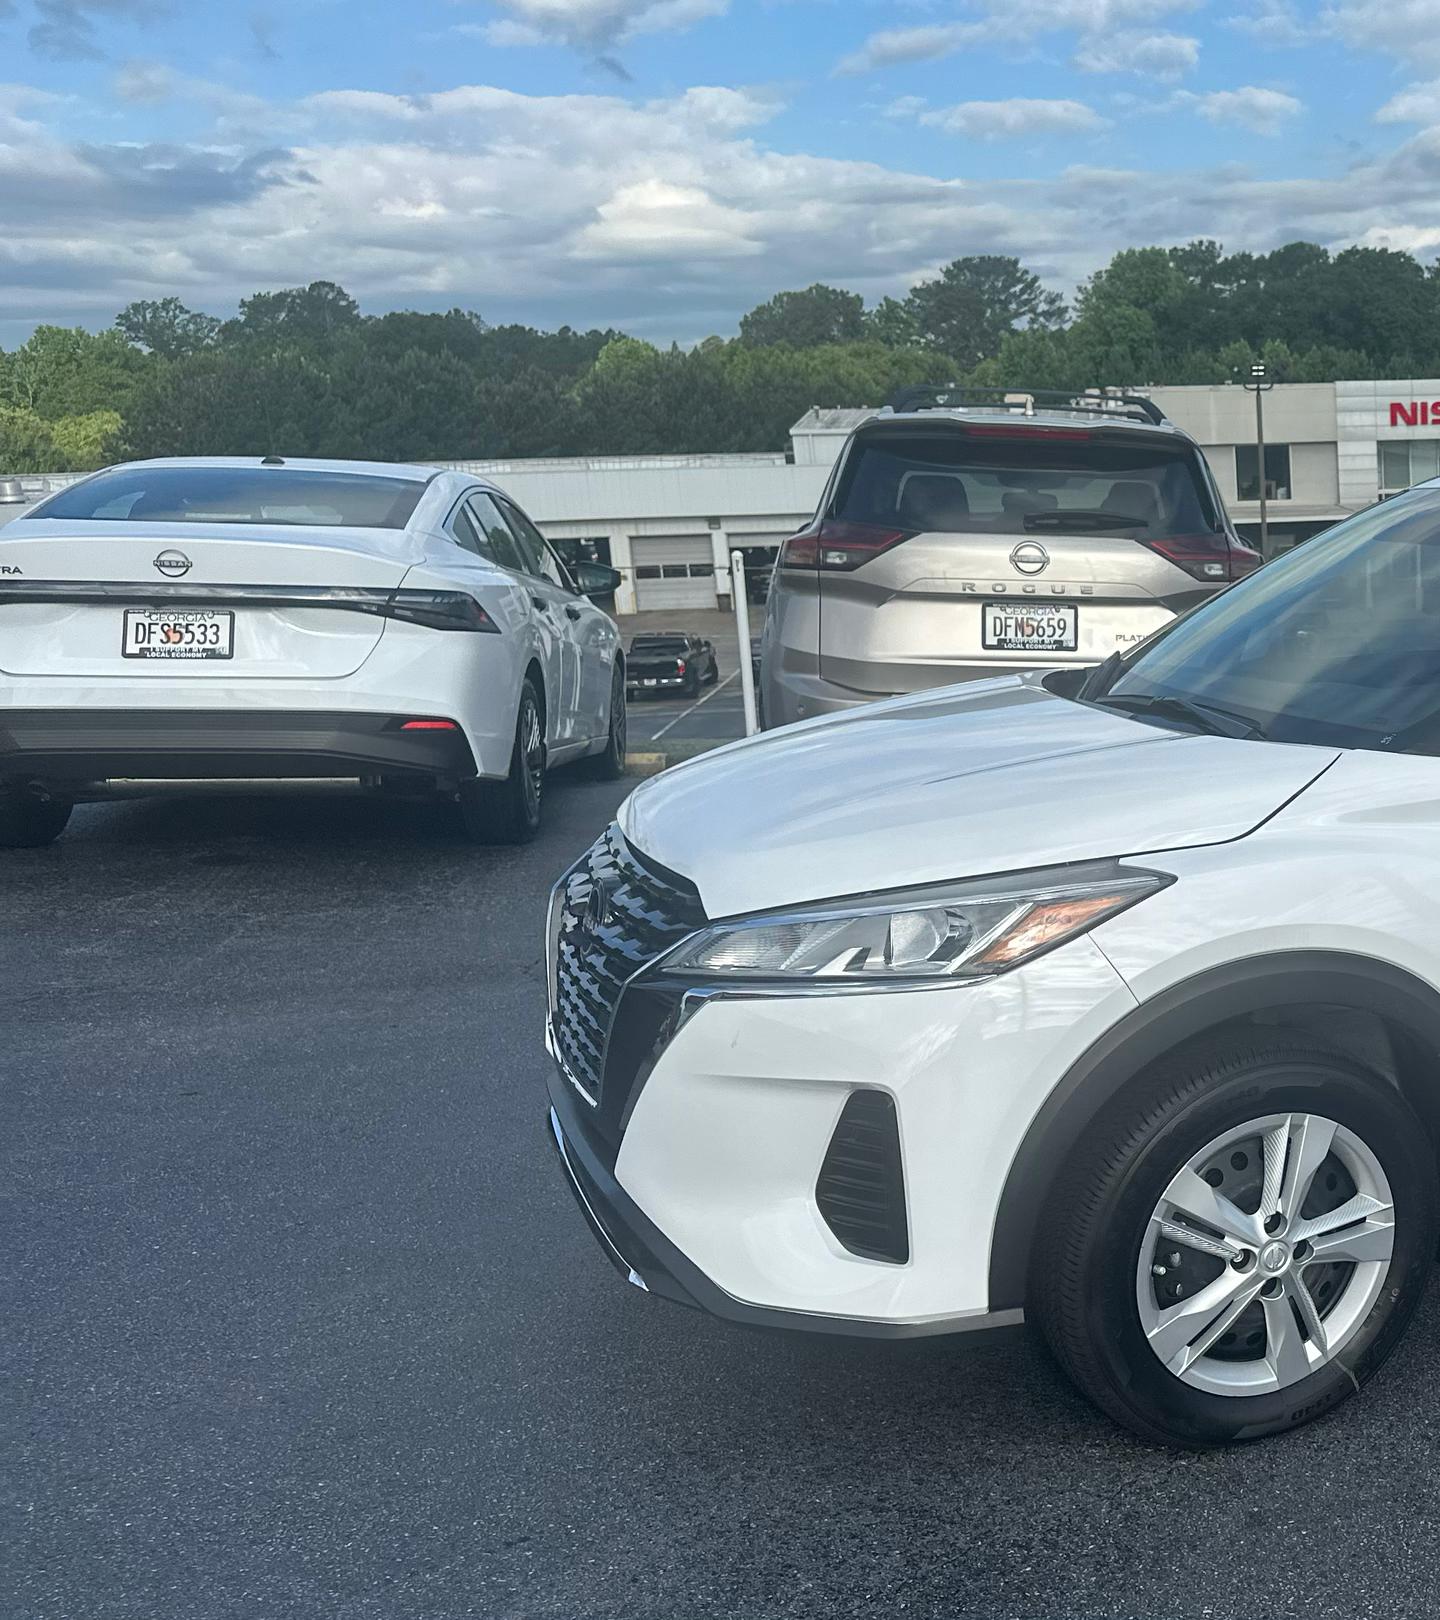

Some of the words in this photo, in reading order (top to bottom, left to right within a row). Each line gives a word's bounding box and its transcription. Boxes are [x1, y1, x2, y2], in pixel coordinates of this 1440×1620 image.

[153, 559, 192, 567] NISSAN
[961, 582, 1094, 595] ROGUE
[1004, 607, 1055, 616] GEORGIA
[149, 613, 207, 622] GEORGIA
[993, 616, 1067, 638] DFM5659
[134, 622, 220, 645] DFS5533
